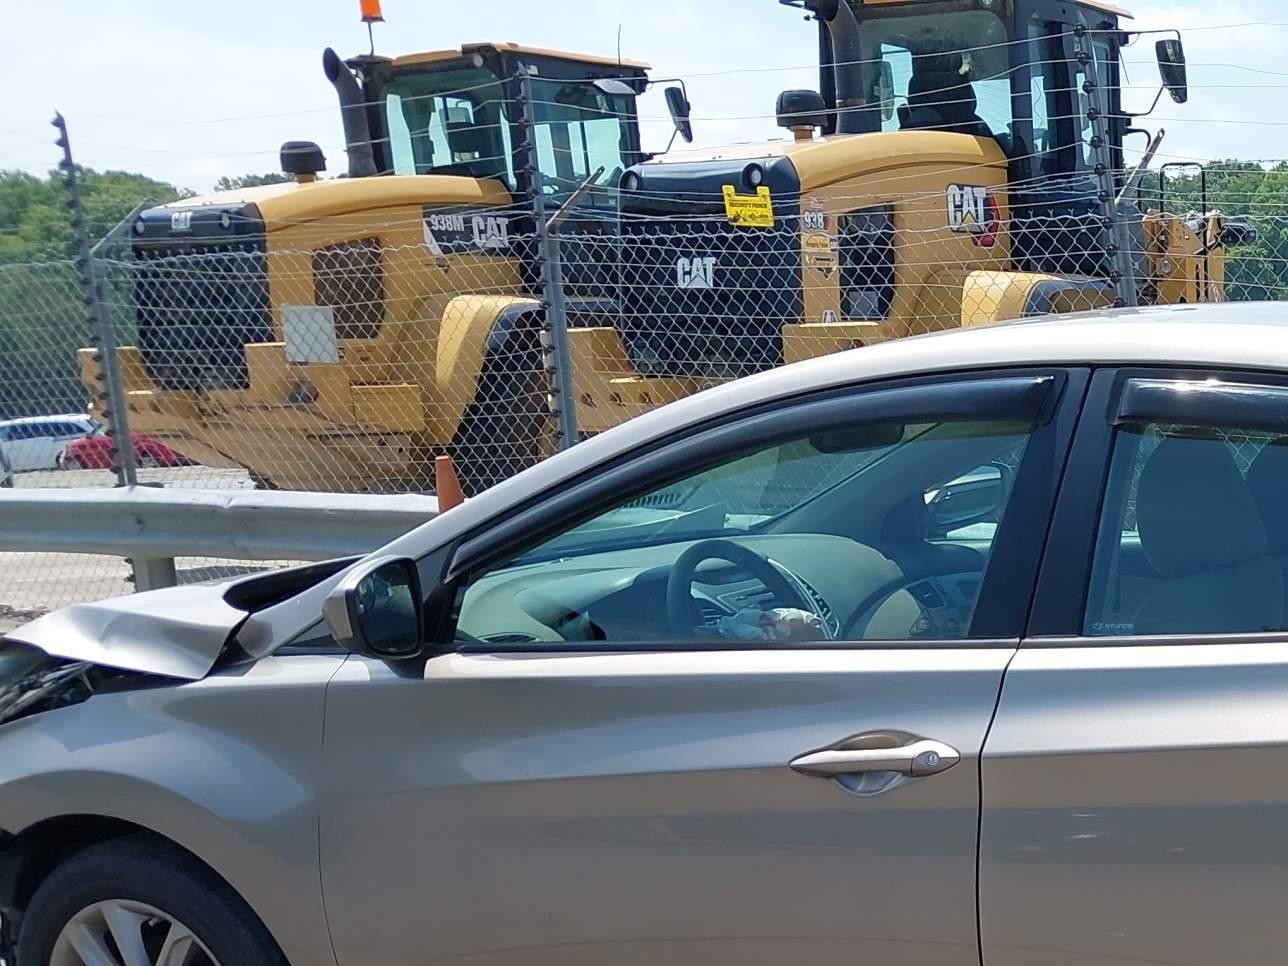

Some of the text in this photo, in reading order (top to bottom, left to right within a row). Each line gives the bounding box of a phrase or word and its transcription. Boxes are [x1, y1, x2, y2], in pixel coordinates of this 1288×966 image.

[171, 211, 193, 229] CAT
[804, 211, 825, 229] 938
[946, 184, 986, 232] CAT
[430, 214, 509, 248] 938M CAT
[677, 256, 716, 289] CAT
